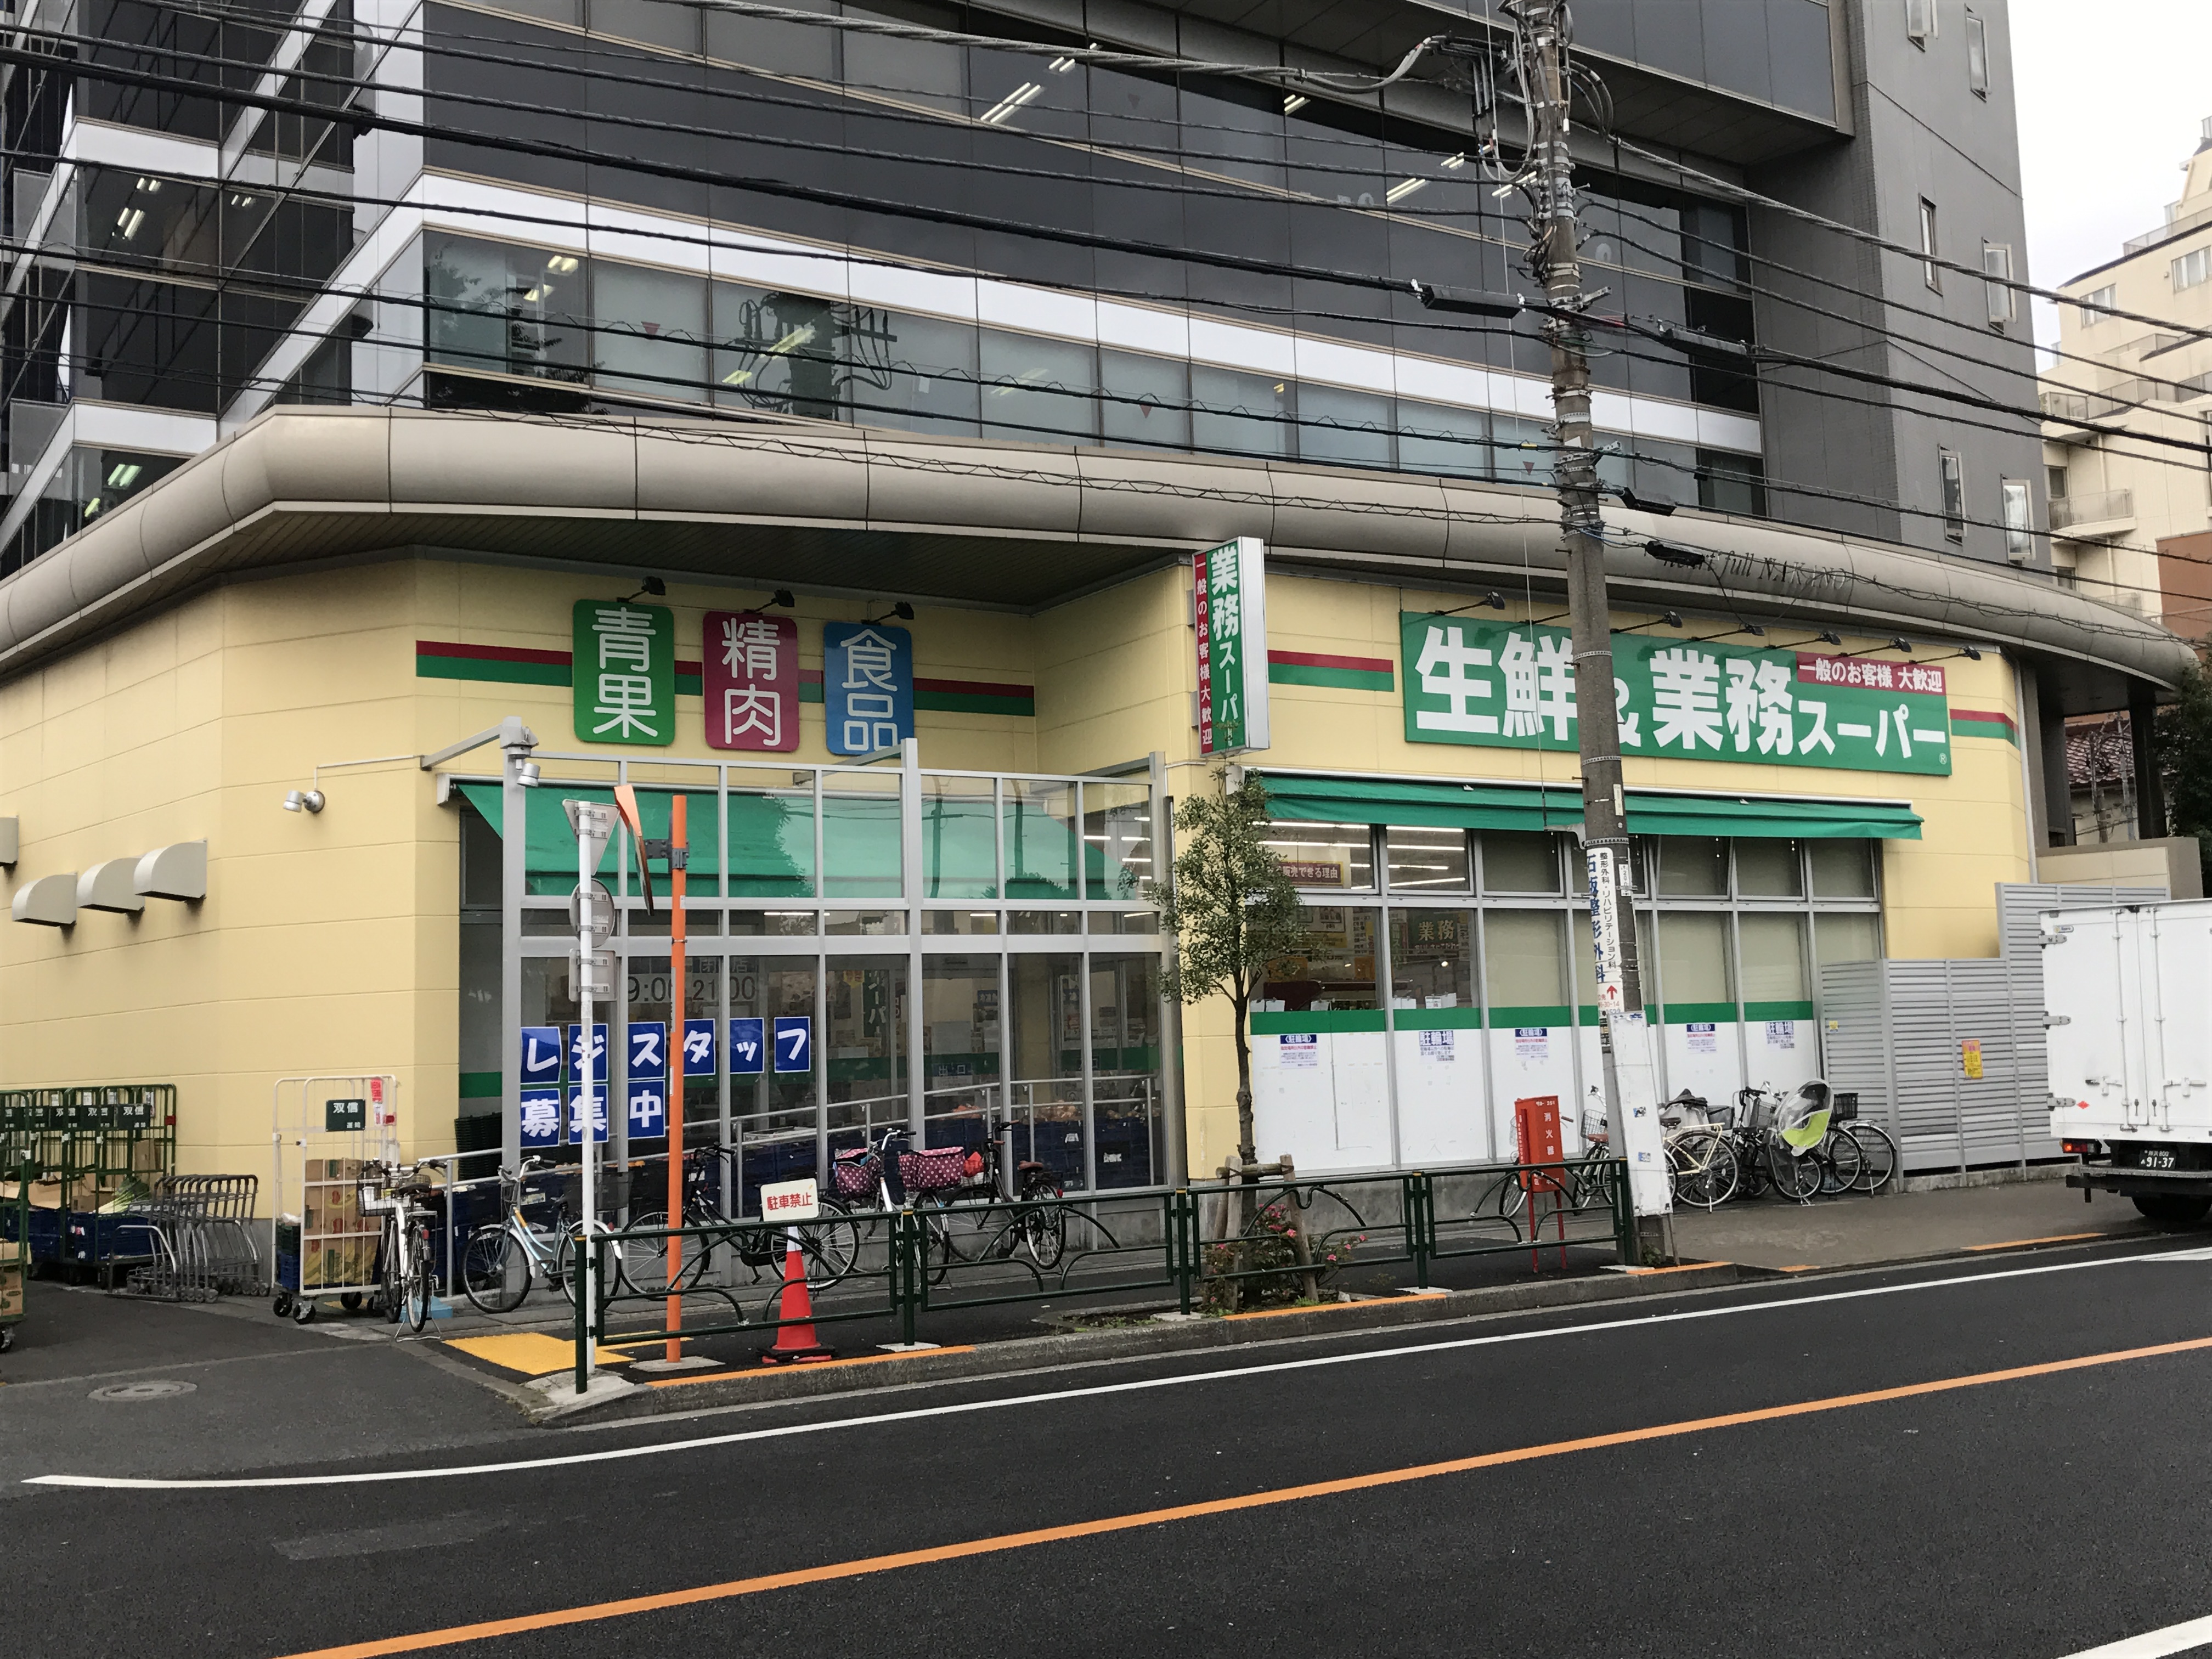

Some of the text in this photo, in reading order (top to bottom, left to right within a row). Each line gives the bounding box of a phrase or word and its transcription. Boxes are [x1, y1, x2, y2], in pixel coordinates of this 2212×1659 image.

[592, 608, 658, 738] 青果
[722, 618, 781, 747] 精肉
[1197, 561, 1213, 744] 一般のお客様大歓迎
[1211, 546, 1239, 746] 業務スーパー
[1799, 658, 1943, 692] 一般のお客様 大歓迎
[839, 628, 898, 751] 食品
[628, 976, 672, 1002] 9:0
[526, 1028, 806, 1073] レジスタッフ
[521, 1090, 662, 1137] 募集中
[767, 1192, 813, 1211] 駐車禁止
